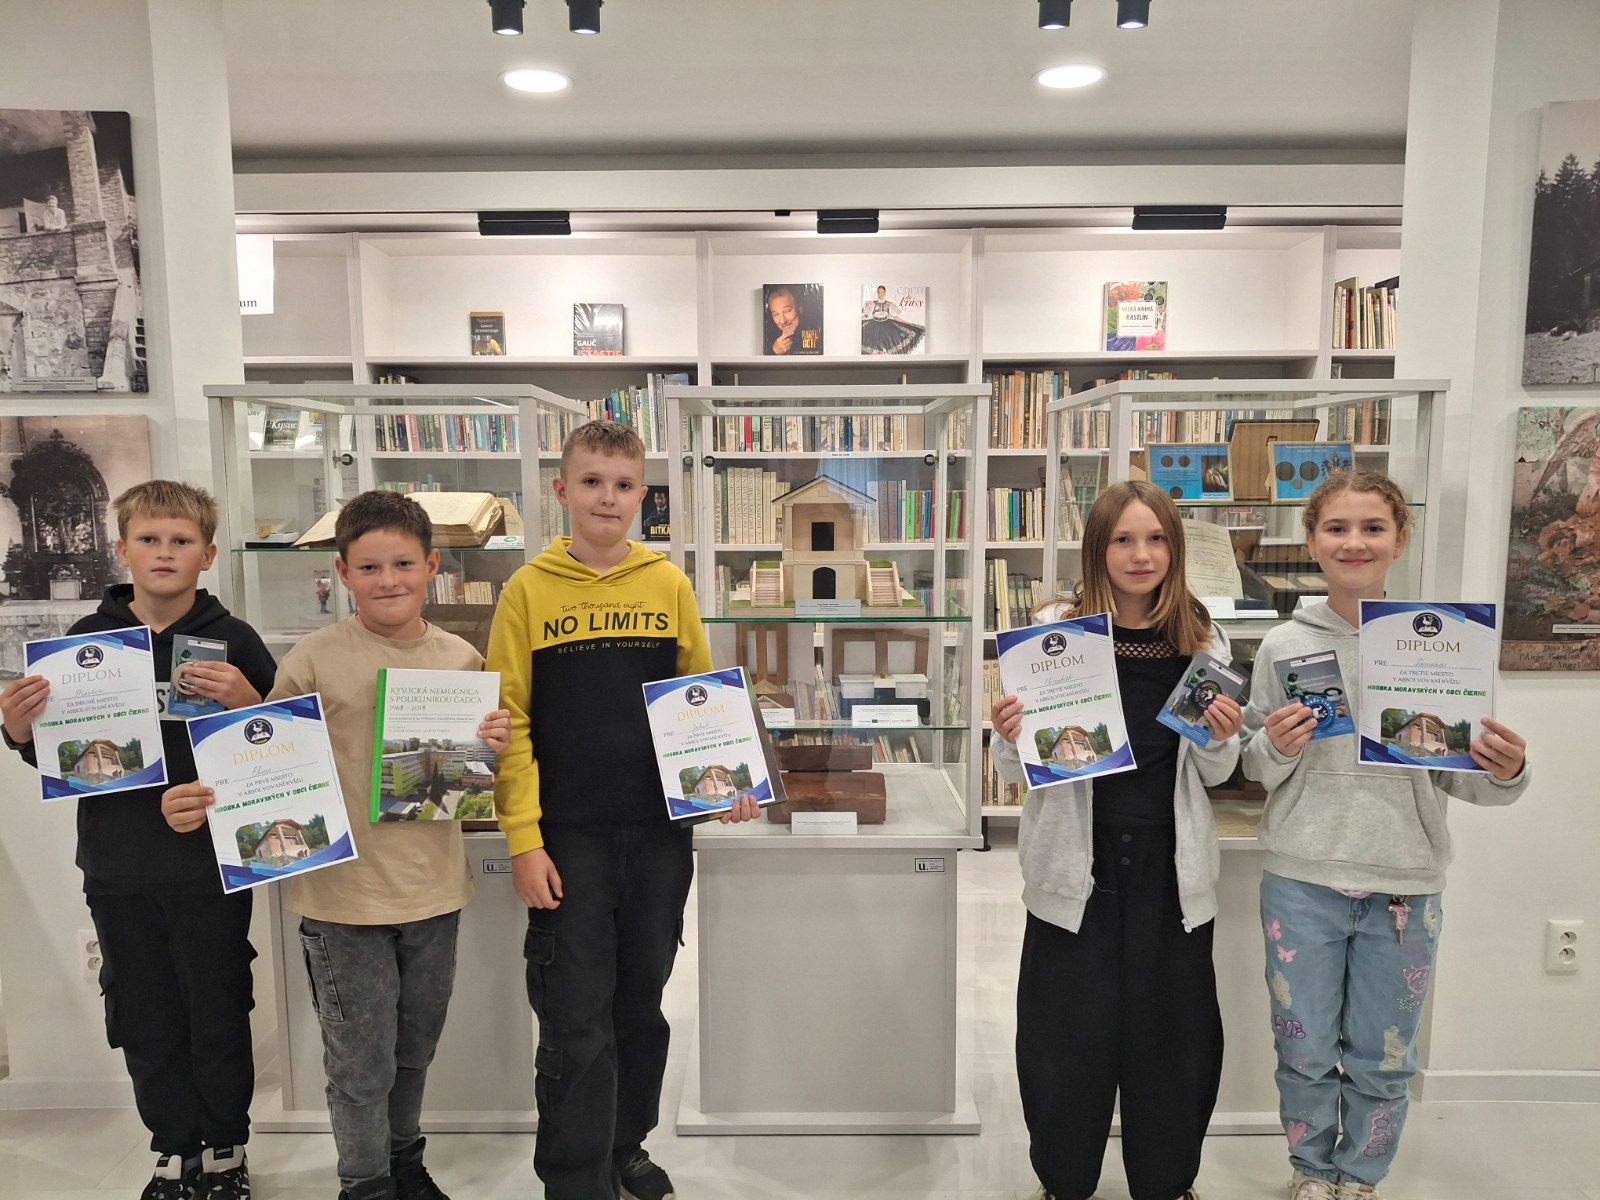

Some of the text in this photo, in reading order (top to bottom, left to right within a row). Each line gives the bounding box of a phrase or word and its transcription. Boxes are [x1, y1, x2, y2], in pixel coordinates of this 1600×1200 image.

[576, 338, 597, 347] GAUČ
[623, 601, 647, 612] eight
[543, 611, 669, 641] NO LIMITS
[557, 643, 597, 654] BELIEVE
[1396, 639, 1461, 653] DIPLOM
[1031, 654, 1085, 674] DIPLOM
[1374, 659, 1389, 667] PRE
[61, 667, 121, 685] DIPLOM
[390, 686, 479, 696] KYSUCKÁ NEMOCNICA
[395, 695, 452, 703] POLIKLINIKOU
[453, 695, 482, 704] ČADCA
[677, 704, 725, 721] DIPLOM
[232, 741, 295, 765] DIPLOM
[215, 777, 230, 786] PRE
